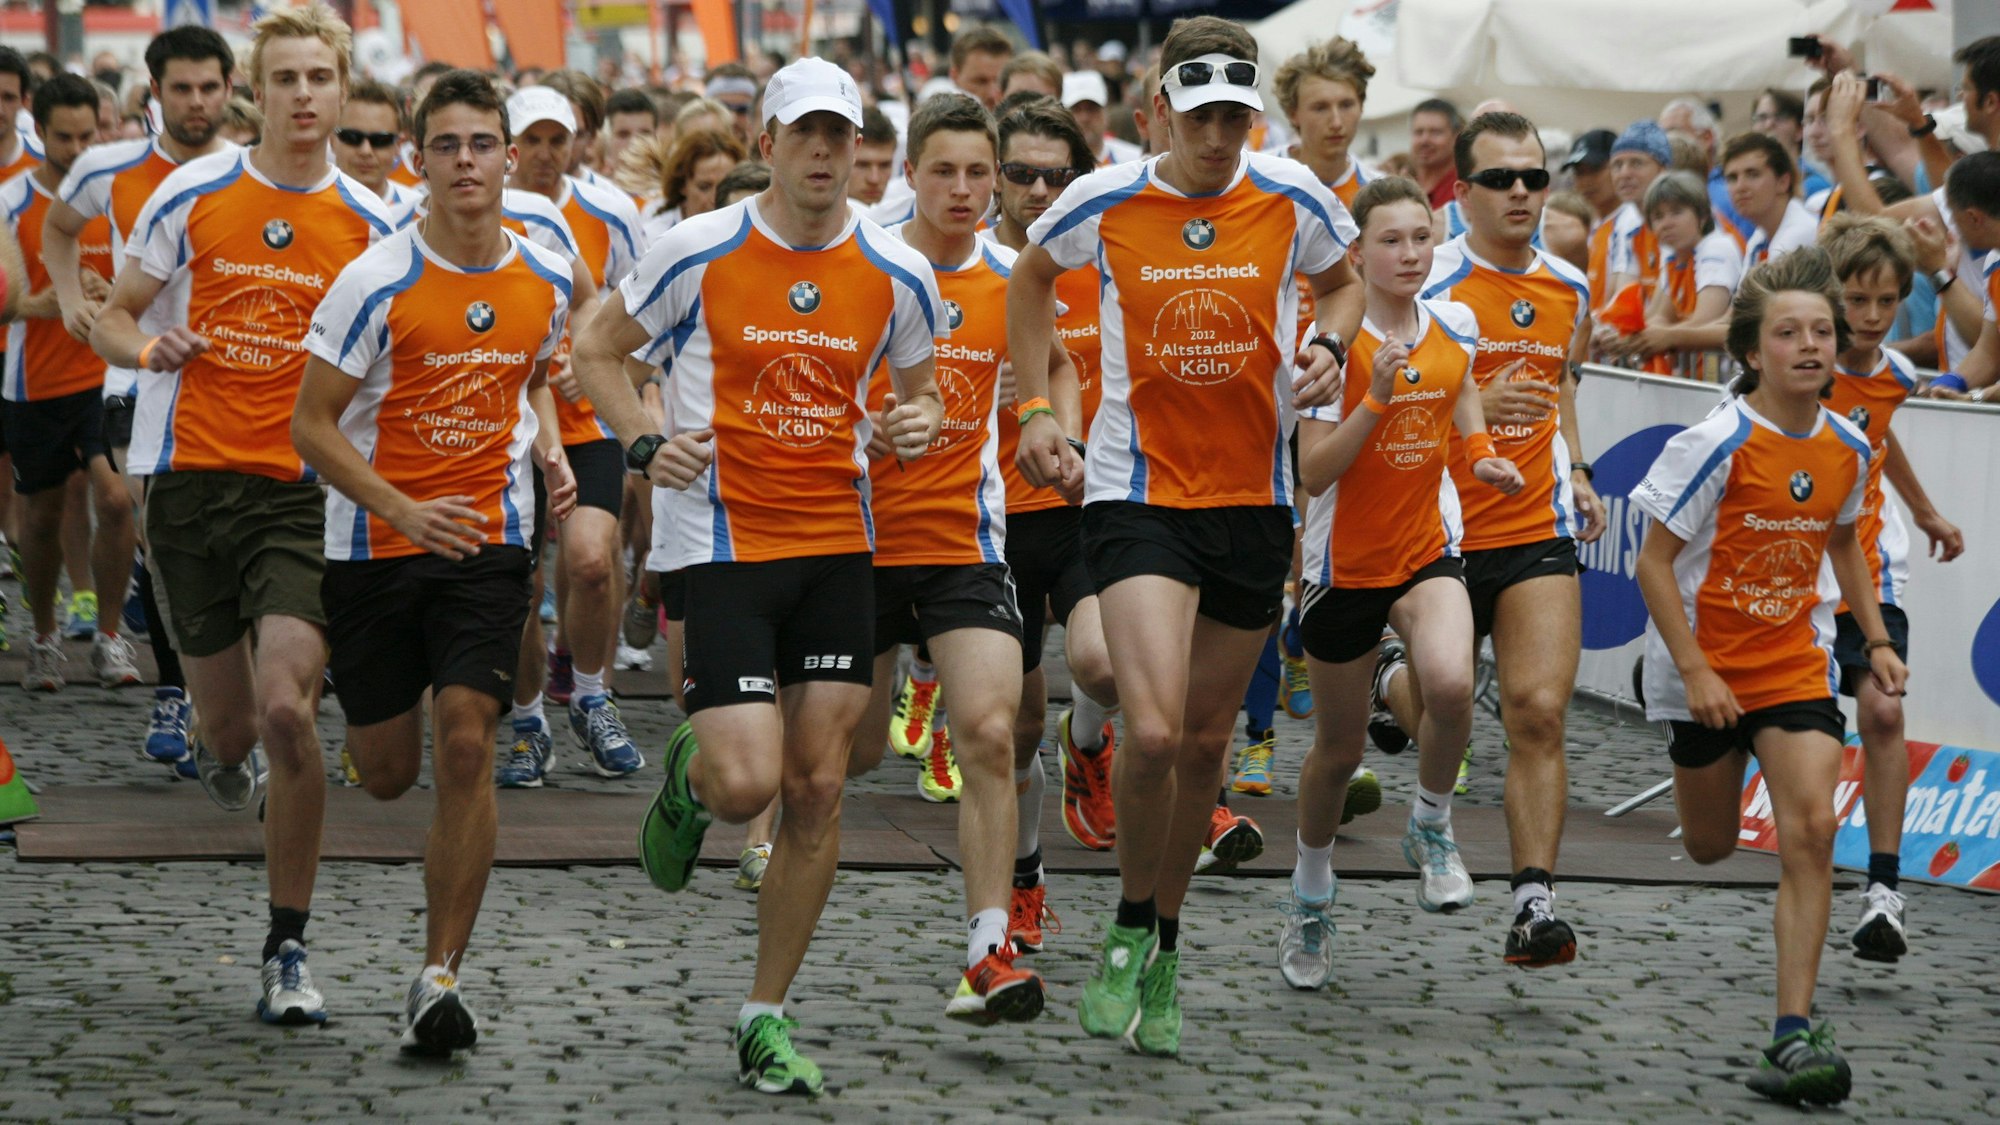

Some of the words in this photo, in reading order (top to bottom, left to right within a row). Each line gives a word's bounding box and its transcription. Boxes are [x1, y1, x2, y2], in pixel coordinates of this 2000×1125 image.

[212, 258, 325, 289] SportScheck
[1140, 262, 1260, 283] SportScheck
[198, 322, 209, 335] 3.
[1190, 330, 1216, 340] 2012
[743, 325, 858, 352] SportScheck
[1145, 343, 1157, 357] 3.
[1161, 336, 1259, 357] Altstadtlauf
[1477, 337, 1565, 358] SportScheck
[226, 343, 272, 367] Köln
[423, 348, 528, 368] SportScheck
[933, 343, 995, 363] tScheck
[1180, 358, 1230, 376] Köln
[790, 392, 812, 402] 2012
[1388, 388, 1446, 405] portScheck
[450, 405, 475, 417] 2012
[743, 400, 756, 414] 3.
[760, 401, 848, 418] Altstadtlauf
[418, 411, 507, 432] Altstadtlauf
[778, 418, 824, 437] Köln
[430, 429, 477, 448] Köln
[1375, 443, 1384, 452] 3.
[1394, 452, 1423, 463] Köln
[1721, 576, 1734, 592] 3.
